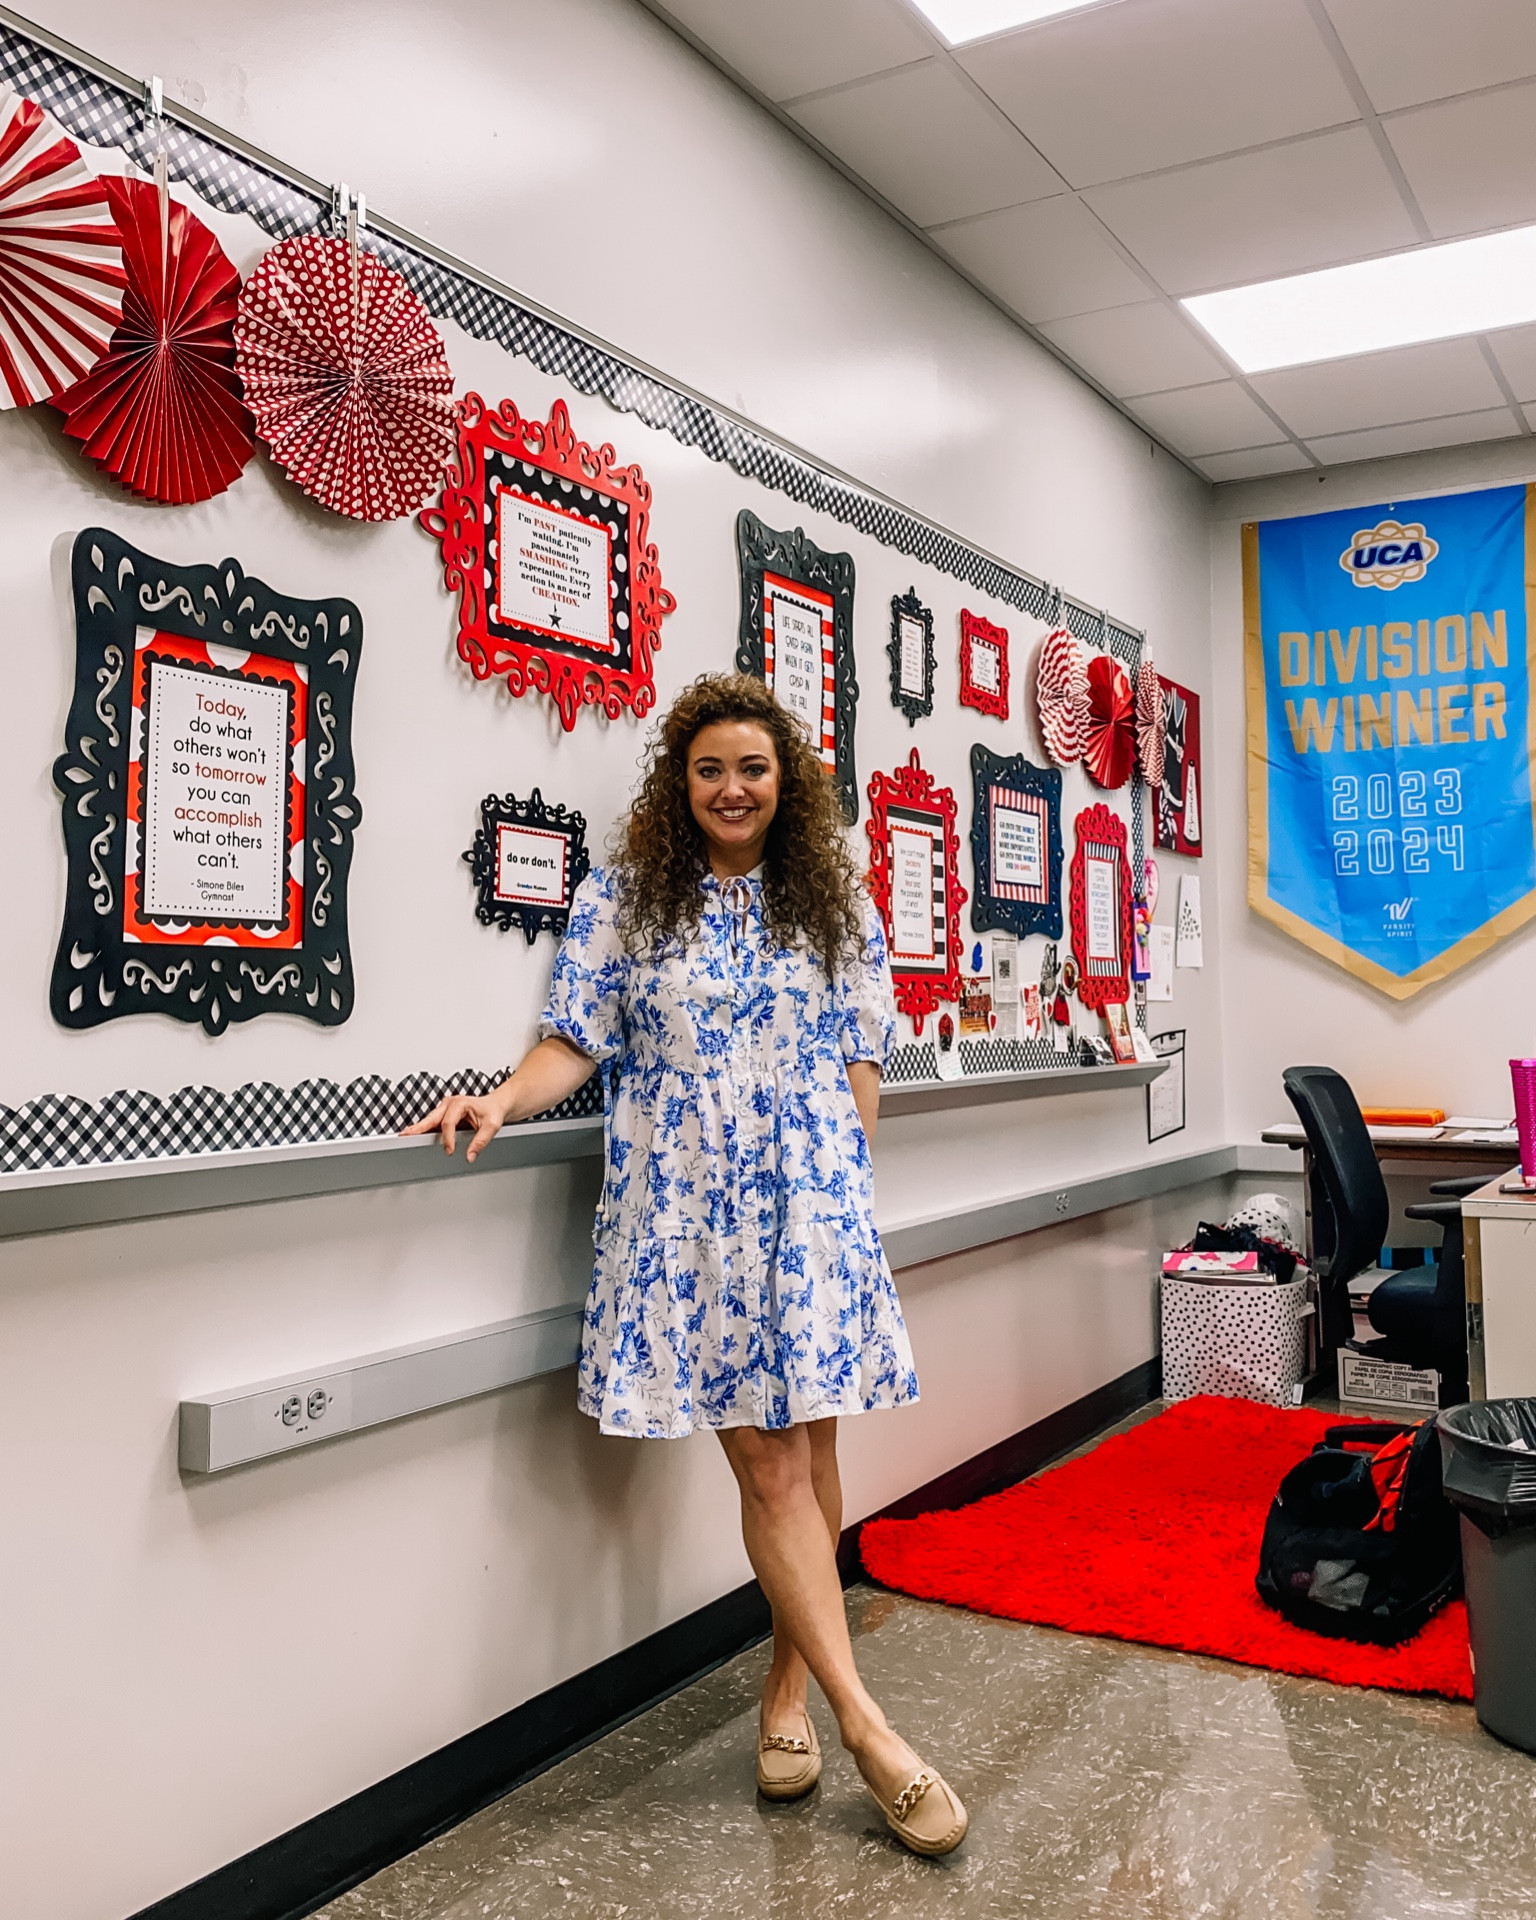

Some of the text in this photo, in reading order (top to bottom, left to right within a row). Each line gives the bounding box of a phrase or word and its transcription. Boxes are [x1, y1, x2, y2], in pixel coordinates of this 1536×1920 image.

[518, 512, 592, 547] I'm PAST patiently
[531, 541, 580, 564] passionately
[532, 530, 579, 553] waiting. I'm
[520, 548, 590, 579] SMASHING every
[1353, 540, 1425, 569] UCA
[519, 561, 591, 591] expectation. Every
[521, 573, 546, 586] action
[548, 580, 555, 588] is
[569, 588, 580, 598] act
[532, 586, 580, 608] CREATION.
[785, 635, 799, 650] OVER
[1278, 609, 1508, 687] DIVISION
[785, 654, 797, 668] WHEN
[789, 675, 810, 691] CRISP IN
[196, 694, 247, 721] Today,
[1284, 681, 1507, 755] WINNER
[190, 716, 253, 741] do what
[174, 738, 266, 765] others won't
[172, 762, 266, 786] so tomorrow
[187, 786, 251, 806] you can
[1333, 768, 1463, 822] 2023
[174, 806, 263, 829] accomplish
[174, 826, 263, 850] what others
[1022, 826, 1035, 834] WORLD
[198, 852, 239, 870] can't.
[507, 853, 556, 870] do or don't.
[1023, 855, 1037, 863] WORLD
[1335, 825, 1465, 877] 2024
[197, 879, 224, 890] Simone
[227, 881, 245, 891] Biles
[201, 891, 234, 902] Gymnast
[1359, 1361, 1393, 1370] XEROGRAPHIC
